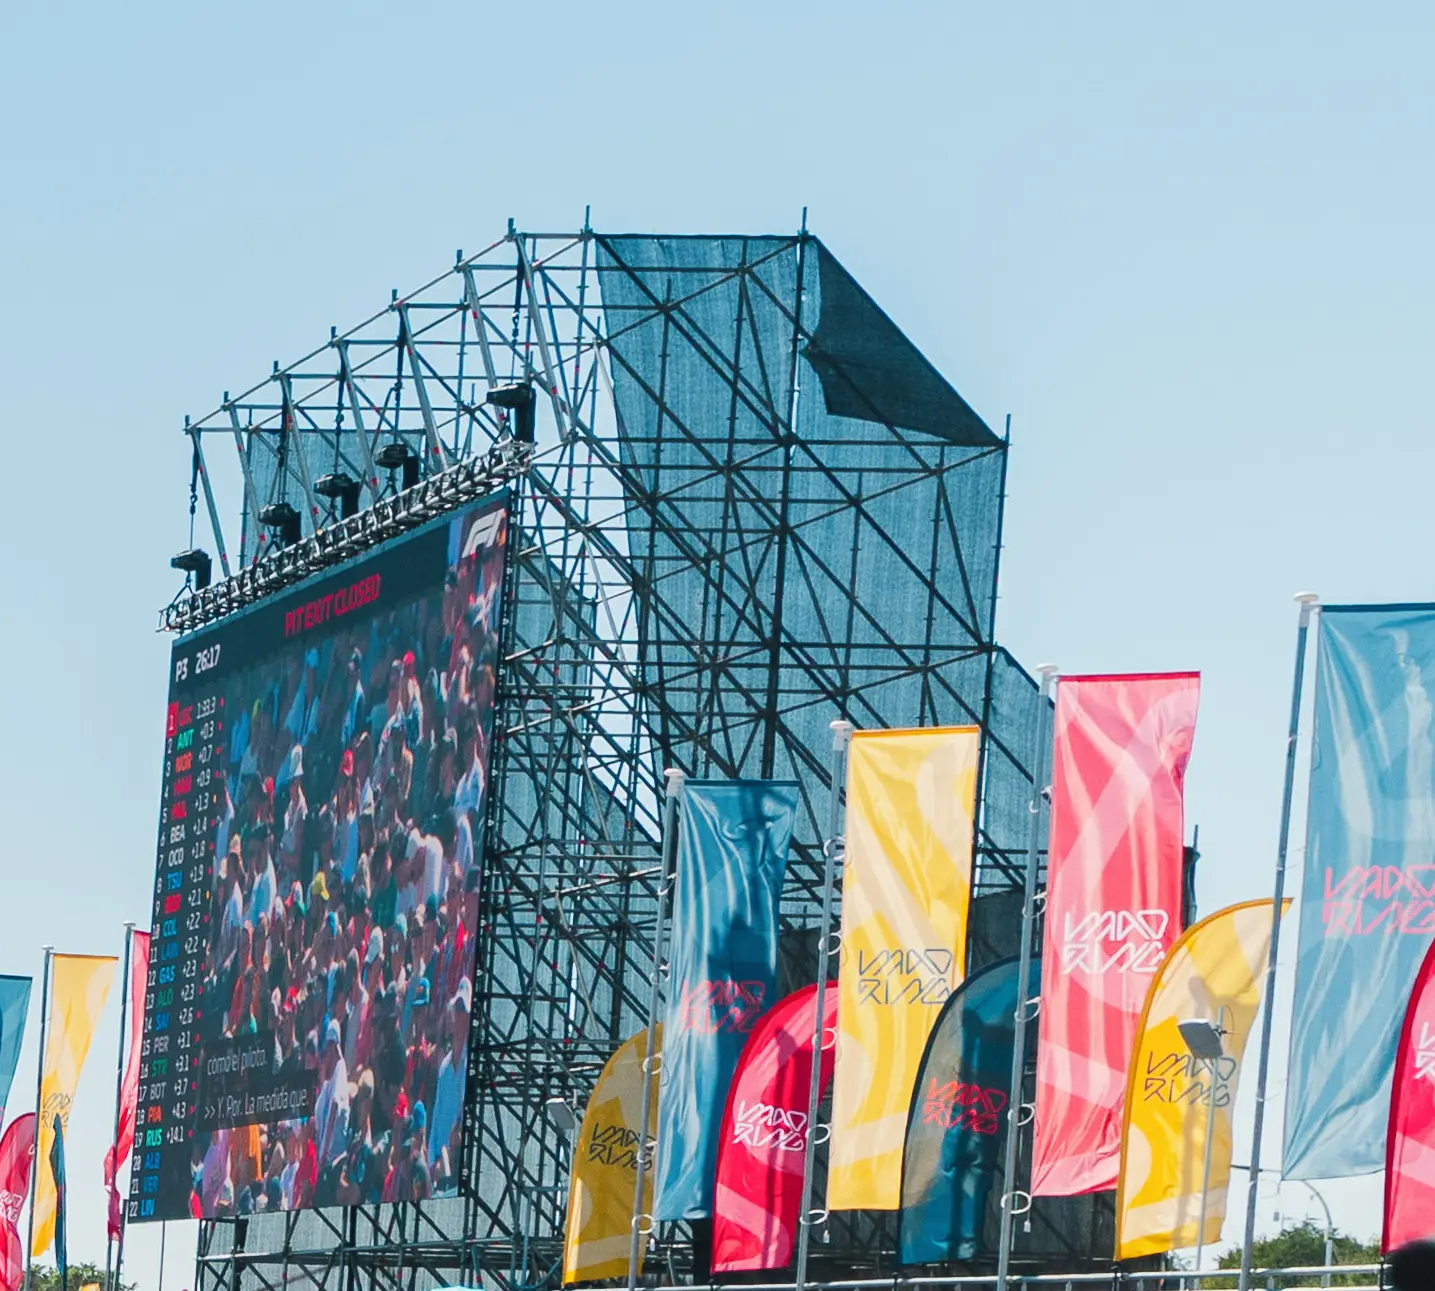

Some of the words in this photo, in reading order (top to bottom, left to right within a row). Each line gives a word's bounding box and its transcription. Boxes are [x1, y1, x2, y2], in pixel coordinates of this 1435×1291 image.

[285, 608, 304, 637] PIT
[305, 594, 333, 630] EXIT
[334, 573, 381, 617] CLOSED
[175, 657, 188, 682] P3
[195, 644, 221, 674] 26:17
[170, 824, 186, 844] BEA
[168, 847, 184, 867] OCO
[159, 965, 175, 984] GAS
[154, 1035, 169, 1053] PER
[150, 1082, 167, 1100] BOT
[146, 1128, 163, 1147] RUS
